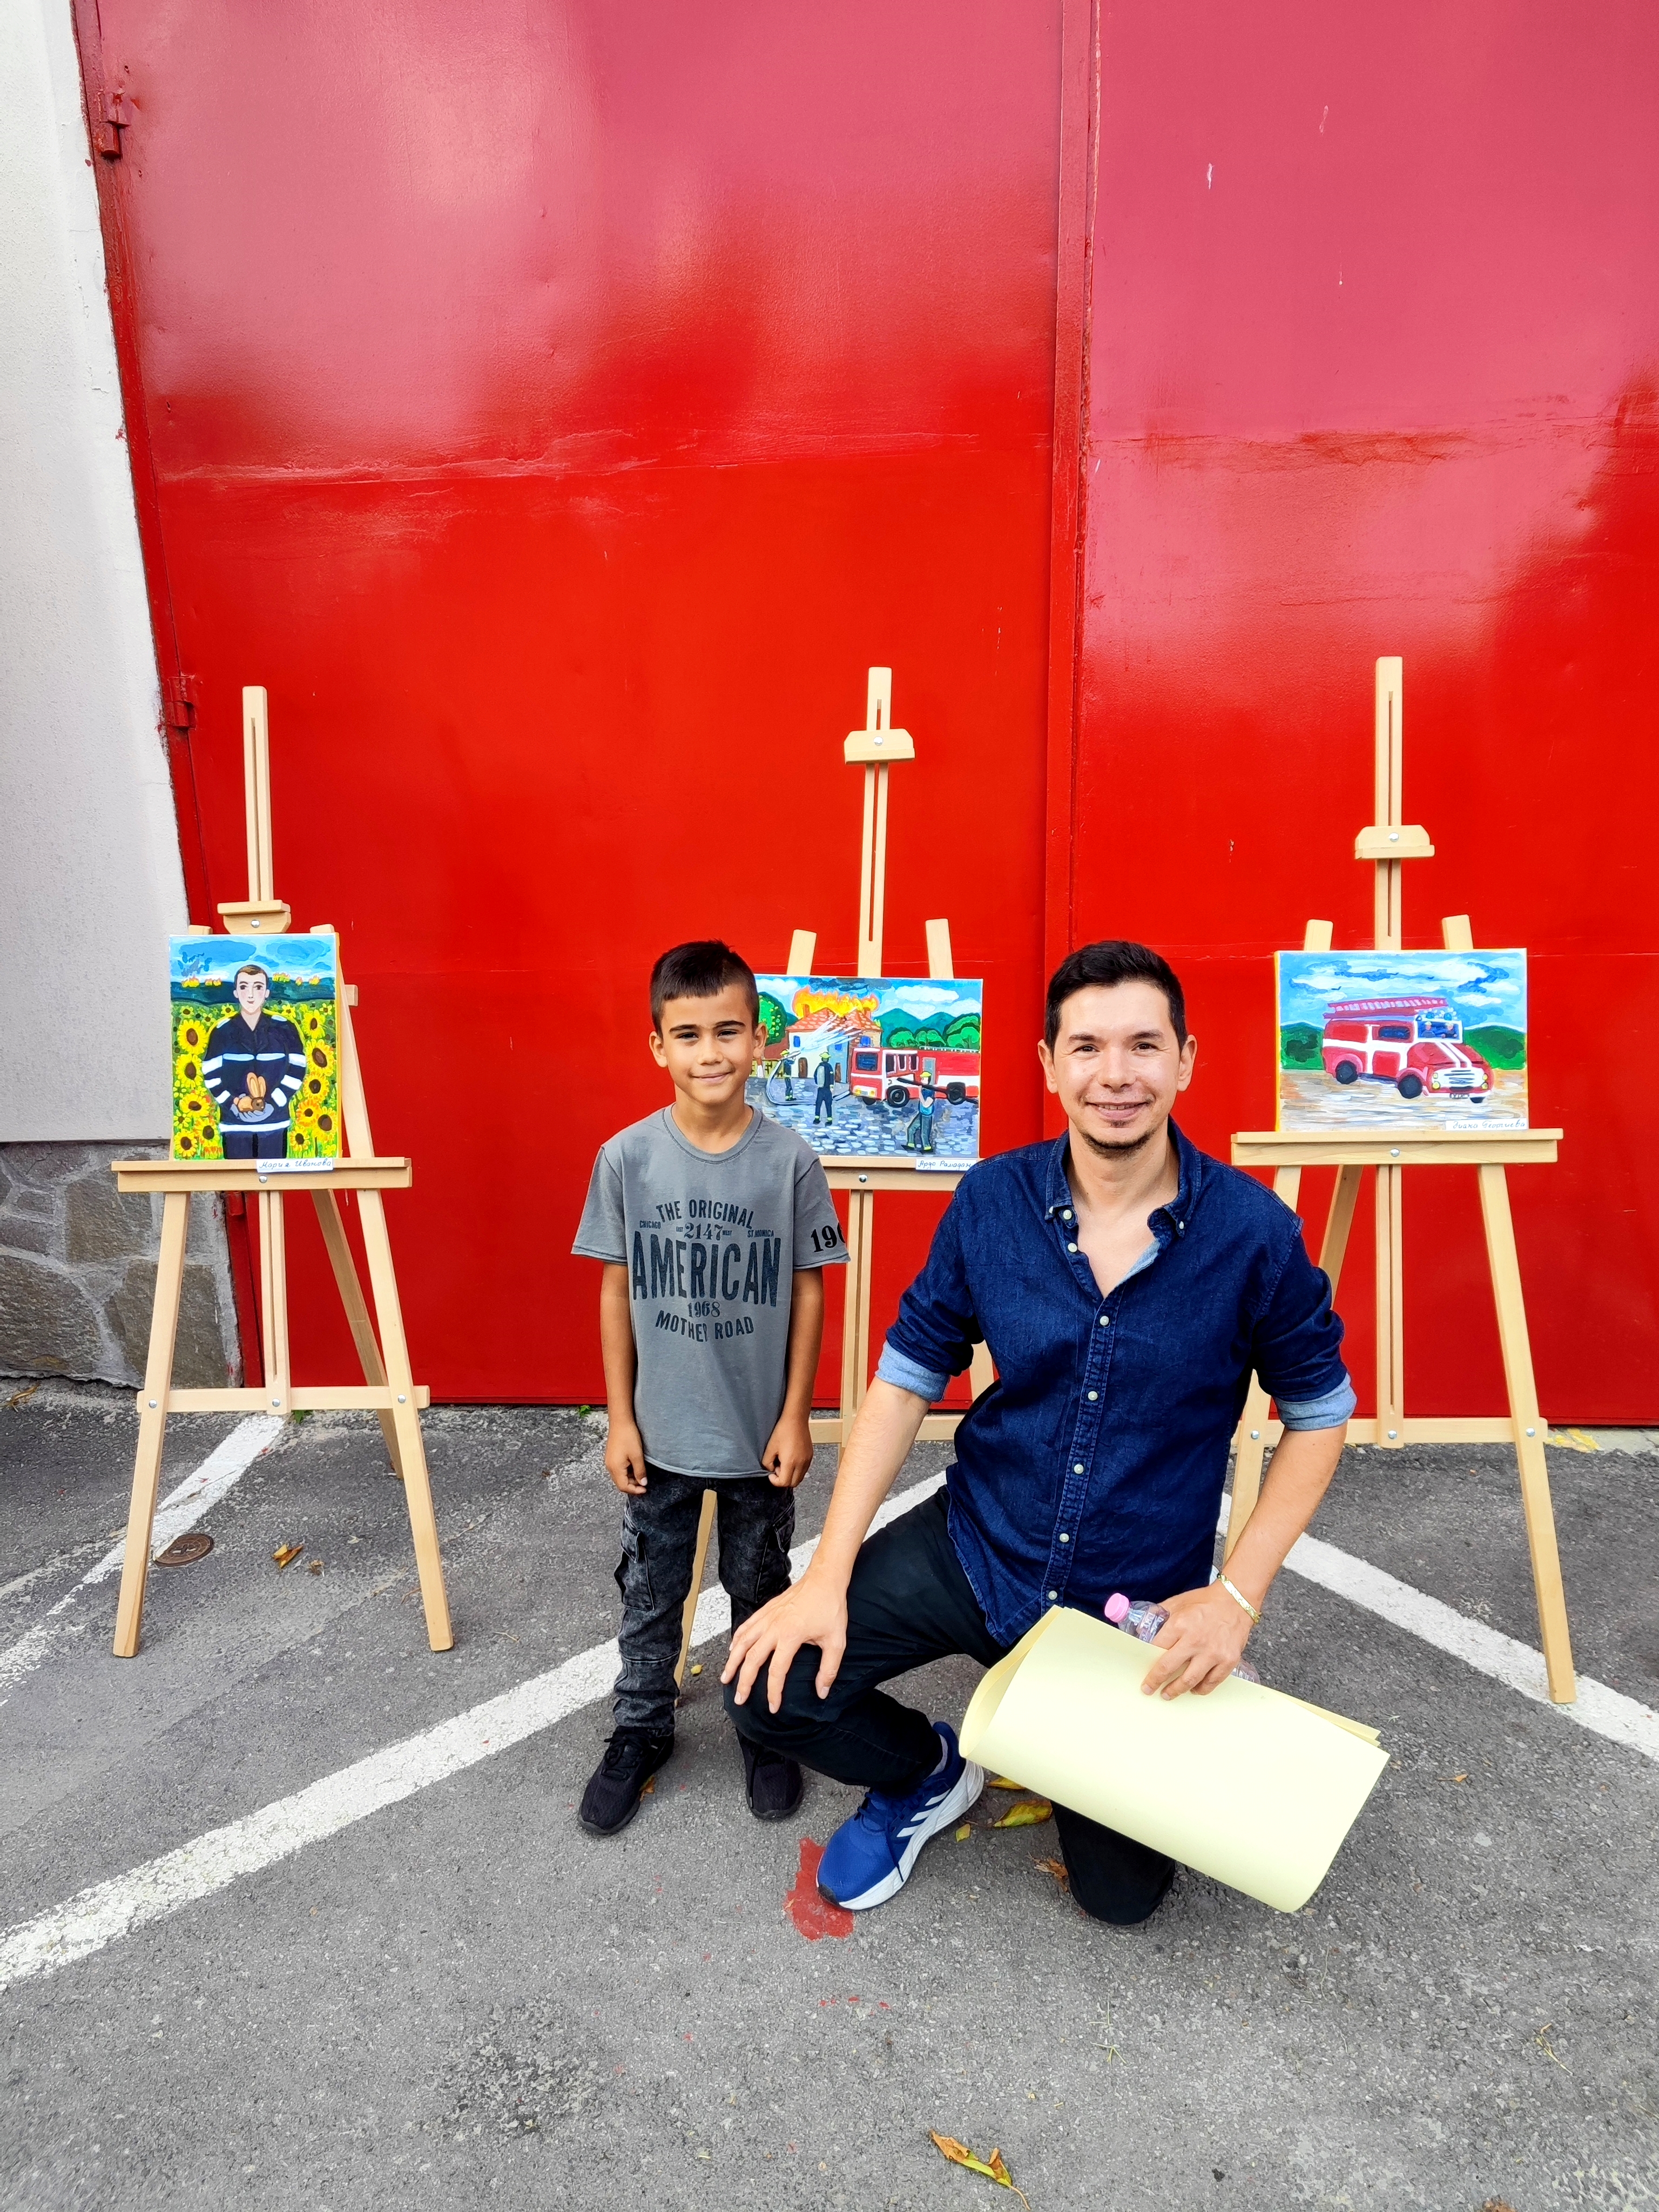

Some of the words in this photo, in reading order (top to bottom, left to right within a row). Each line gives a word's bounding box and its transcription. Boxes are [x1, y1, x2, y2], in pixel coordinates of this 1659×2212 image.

[295, 1158, 332, 1166] Иванова
[656, 1201, 682, 1223] THE
[689, 1199, 754, 1229] ORIGINAL
[639, 1220, 662, 1229] CHICAGO
[684, 1222, 723, 1241] 2147
[632, 1230, 781, 1307] AMERICAN
[687, 1300, 720, 1318] 1968
[714, 1316, 754, 1340] ROAD
